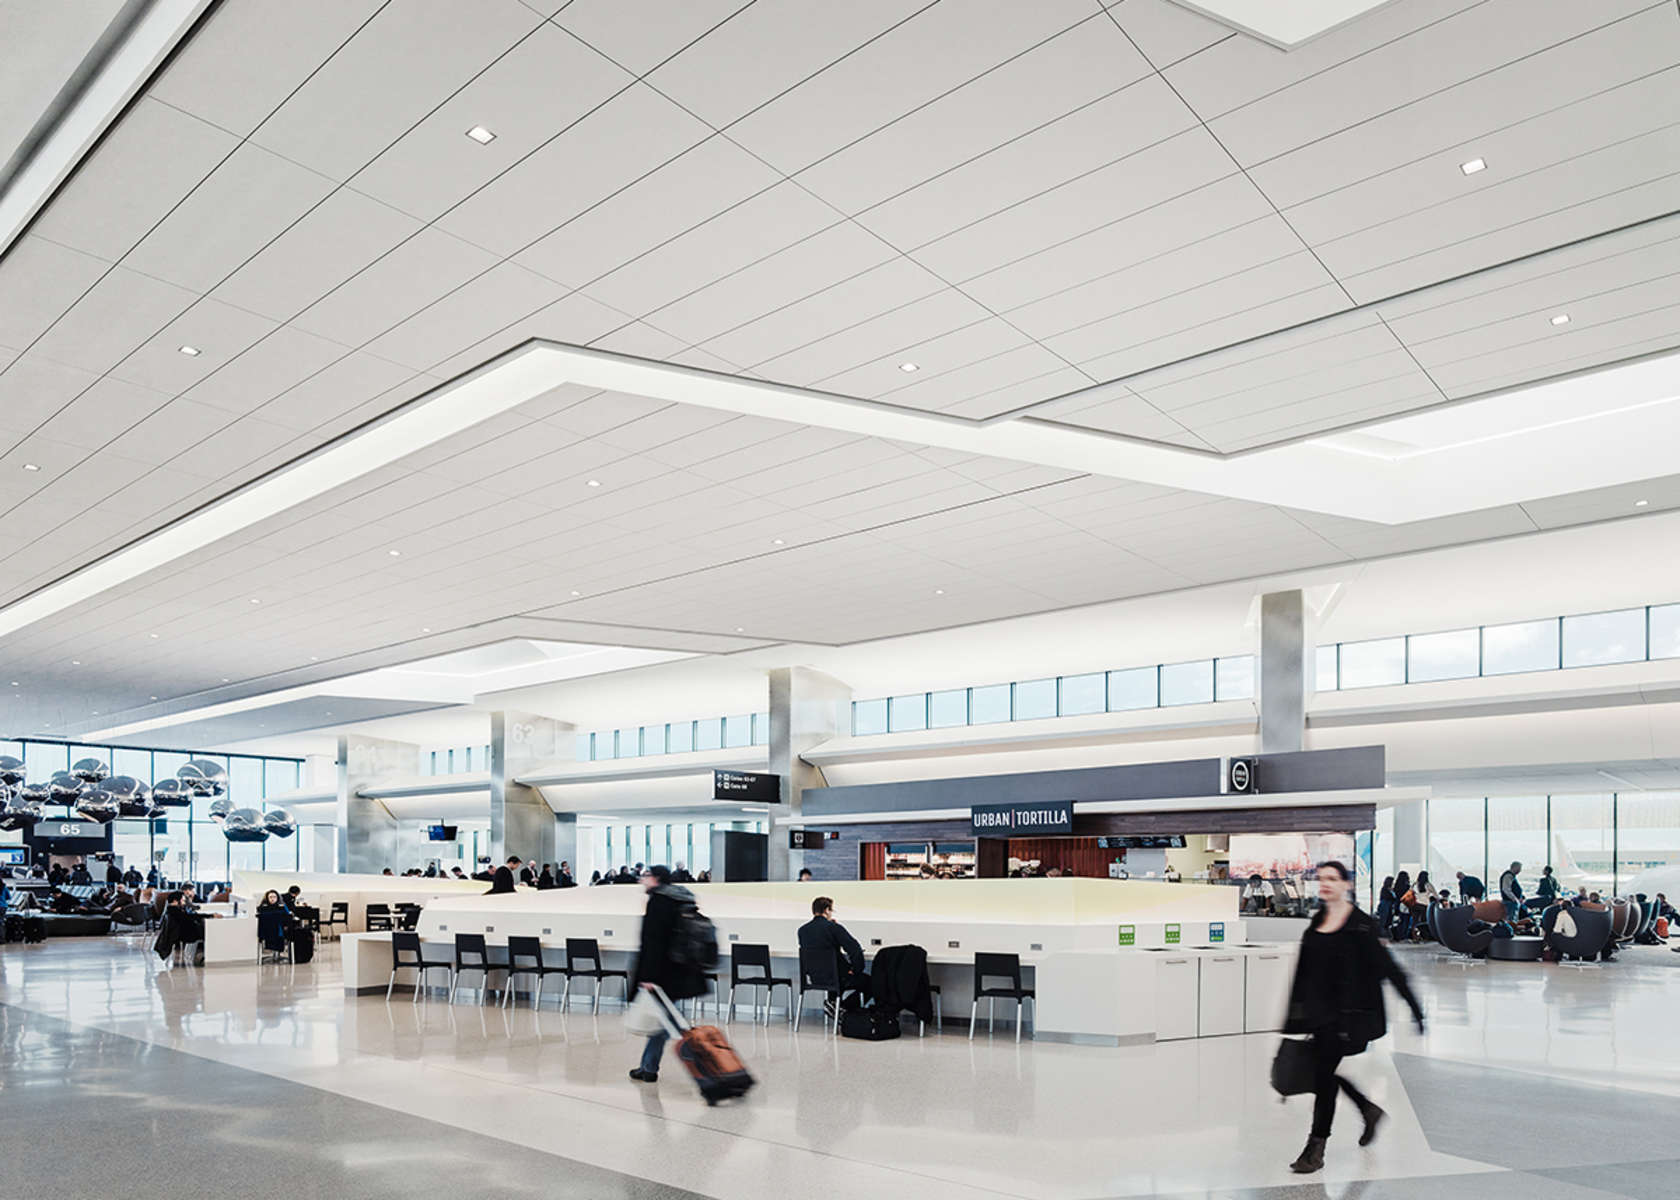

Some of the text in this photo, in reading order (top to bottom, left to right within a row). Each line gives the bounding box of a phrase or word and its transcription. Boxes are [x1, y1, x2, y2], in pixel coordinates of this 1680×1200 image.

[974, 809, 1068, 828] URBAN TORTILLA
[60, 823, 80, 835] 65
